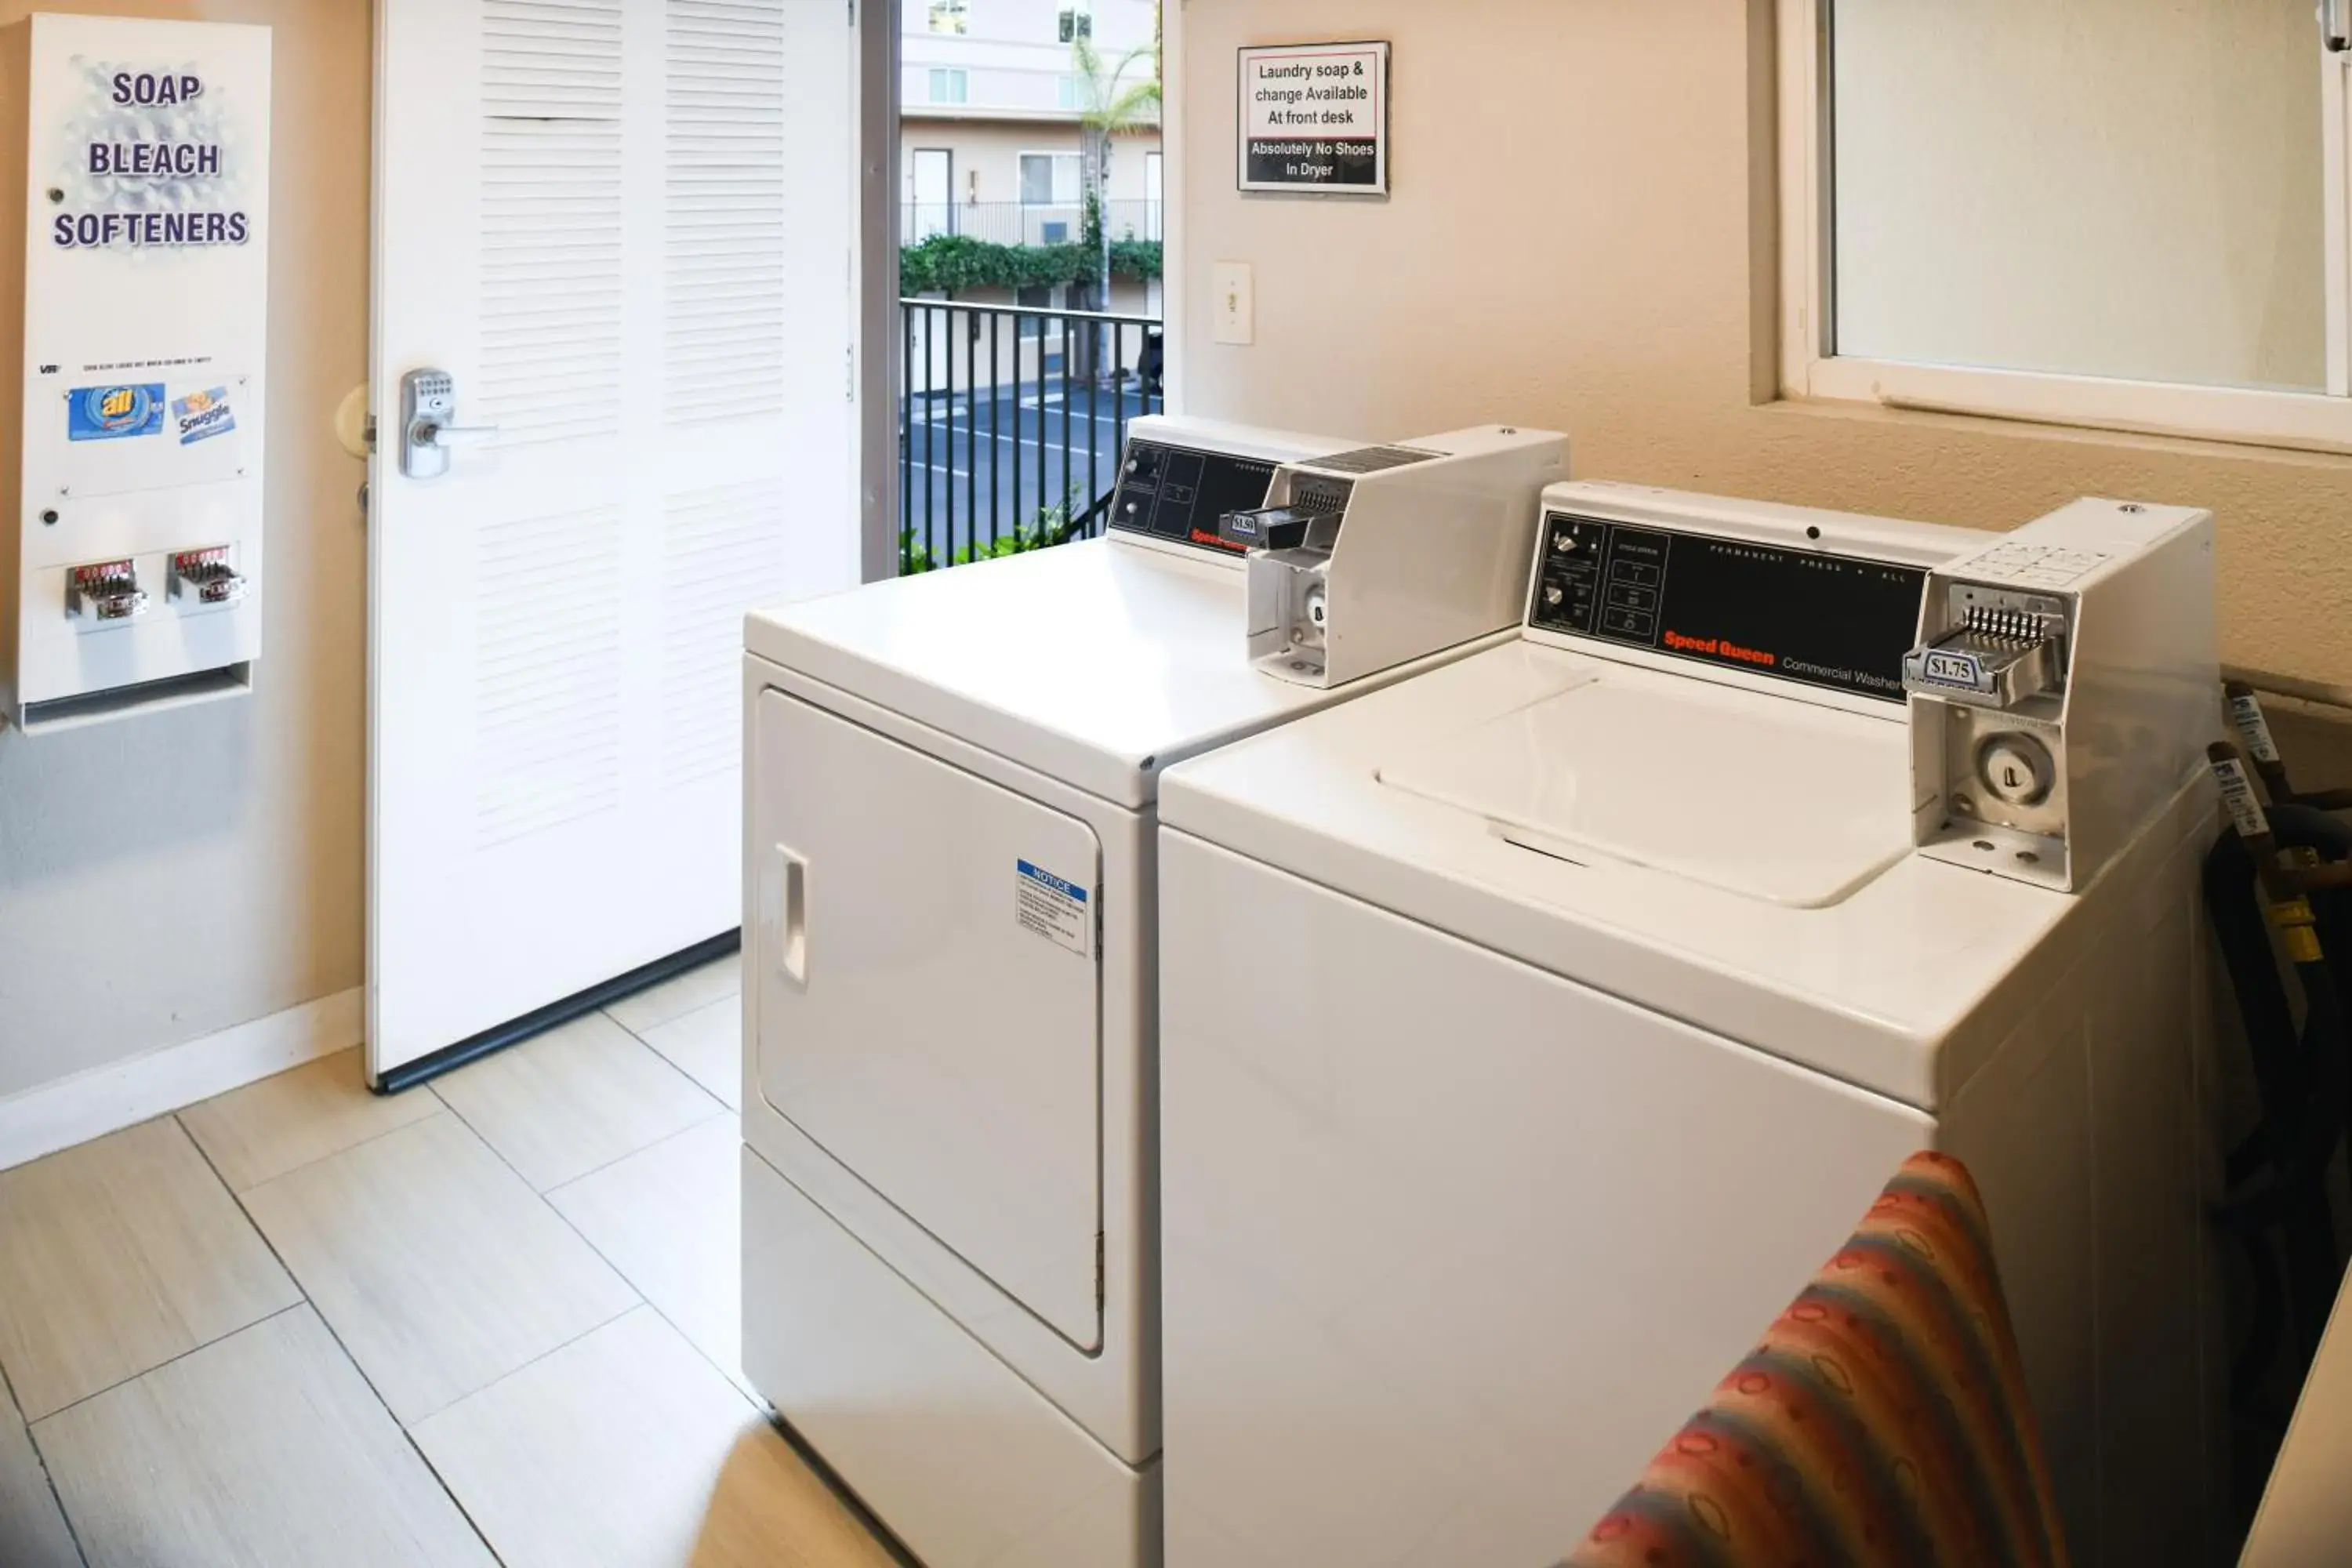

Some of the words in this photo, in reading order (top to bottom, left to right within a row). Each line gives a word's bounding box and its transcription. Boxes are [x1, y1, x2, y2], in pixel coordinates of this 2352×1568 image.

[1259, 64, 1312, 80] Laundry
[1316, 65, 1349, 79] soap
[1353, 60, 1363, 76] &
[112, 72, 201, 104] SOAP
[1255, 87, 1302, 103] change
[1305, 85, 1367, 100] Available
[1267, 110, 1283, 124] At
[1286, 110, 1318, 124] front
[1321, 110, 1354, 124] desk
[89, 143, 219, 173] BLEACH
[1251, 143, 1312, 157] Absolutely
[1316, 143, 1333, 155] No
[1335, 142, 1374, 155] Shoes
[1286, 162, 1298, 176] In
[1301, 163, 1333, 179] Dryer
[54, 212, 247, 245] SOFTENERS
[102, 389, 132, 416] all
[180, 403, 230, 434] Snuggle
[1664, 630, 1718, 654] Speed
[1719, 641, 1775, 666] Queen
[1783, 656, 1852, 681] Commercial
[1855, 670, 1902, 691] Washer
[1931, 658, 1970, 678] $1.75
[1033, 868, 1070, 893] NOTICE
